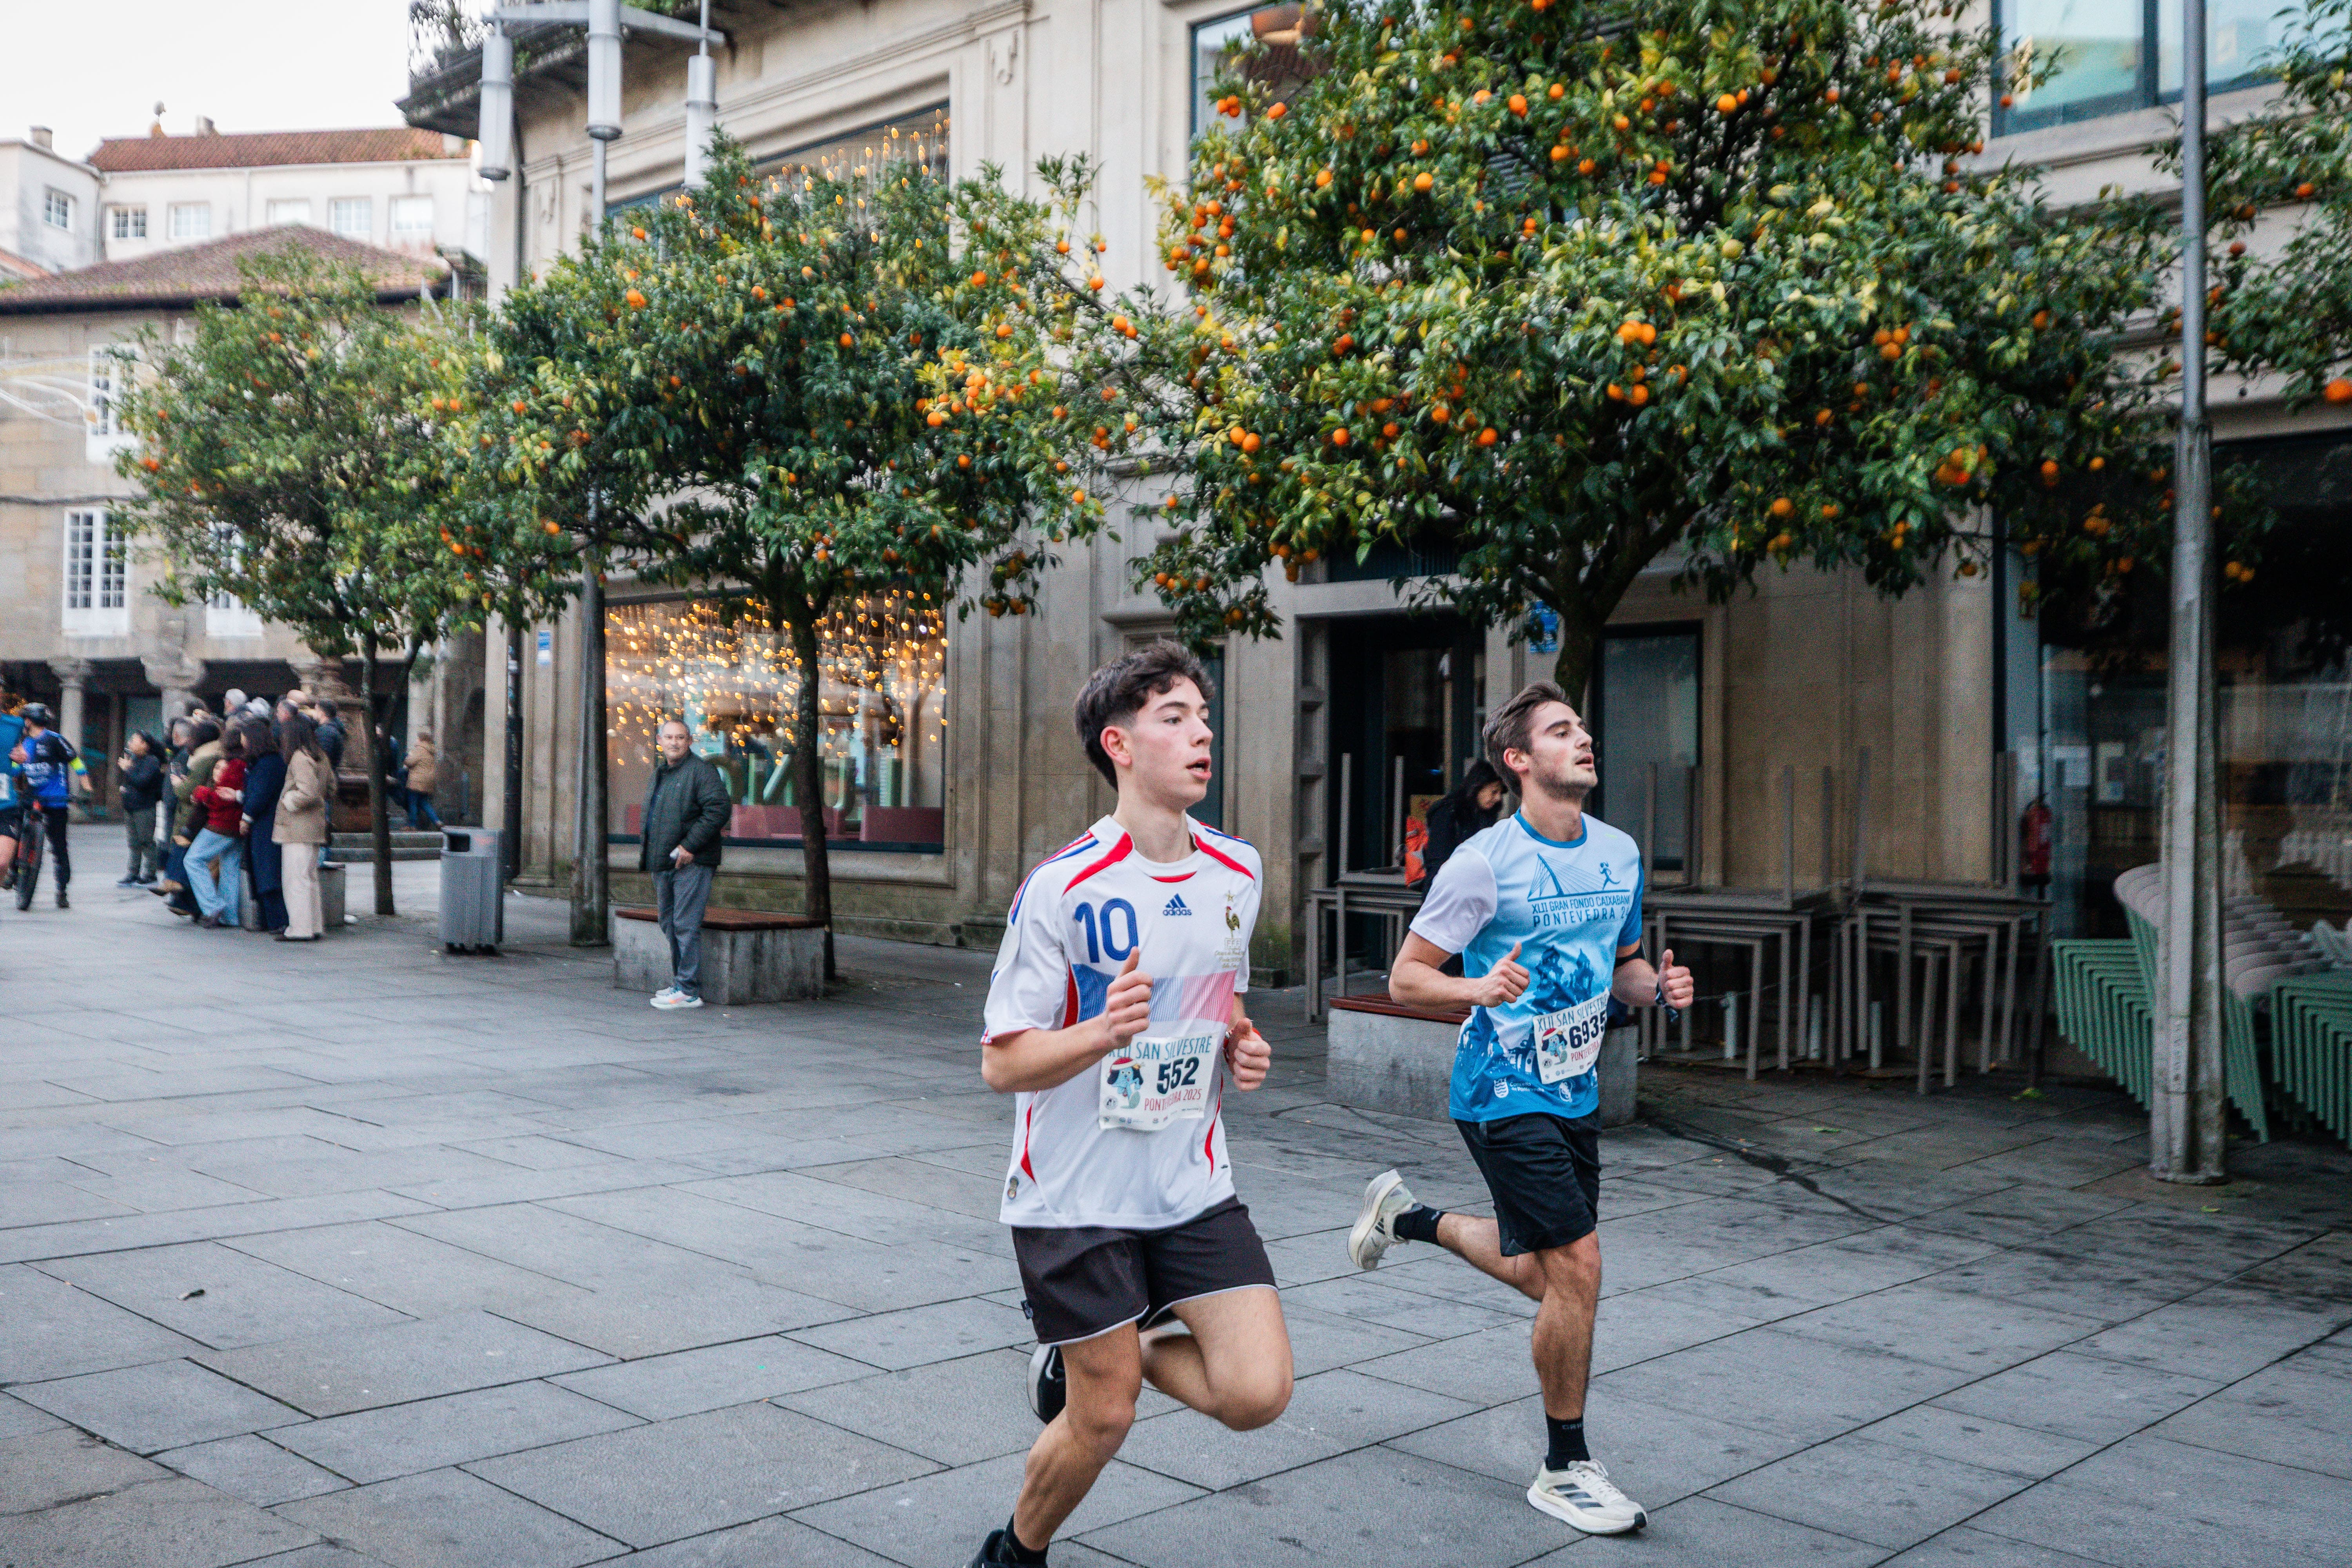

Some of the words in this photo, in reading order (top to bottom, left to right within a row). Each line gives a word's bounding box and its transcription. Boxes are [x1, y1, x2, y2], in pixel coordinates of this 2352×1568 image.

[1163, 907, 1192, 916] adidas
[1550, 900, 1569, 911] GRAN
[1570, 897, 1594, 909] FONDO
[1533, 907, 1615, 927] PONTEVEDRA
[1073, 898, 1138, 963] 10
[1537, 1016, 1554, 1032] XLII
[1555, 1010, 1575, 1027] SAN
[1577, 994, 1607, 1022] SILVESTRE
[1136, 1041, 1160, 1060] SAN
[1165, 1036, 1212, 1060] SILVESTRE
[1571, 1040, 1599, 1062] PONTEVEDRA
[1157, 1056, 1200, 1094] 552
[1183, 1088, 1202, 1100] 2025
